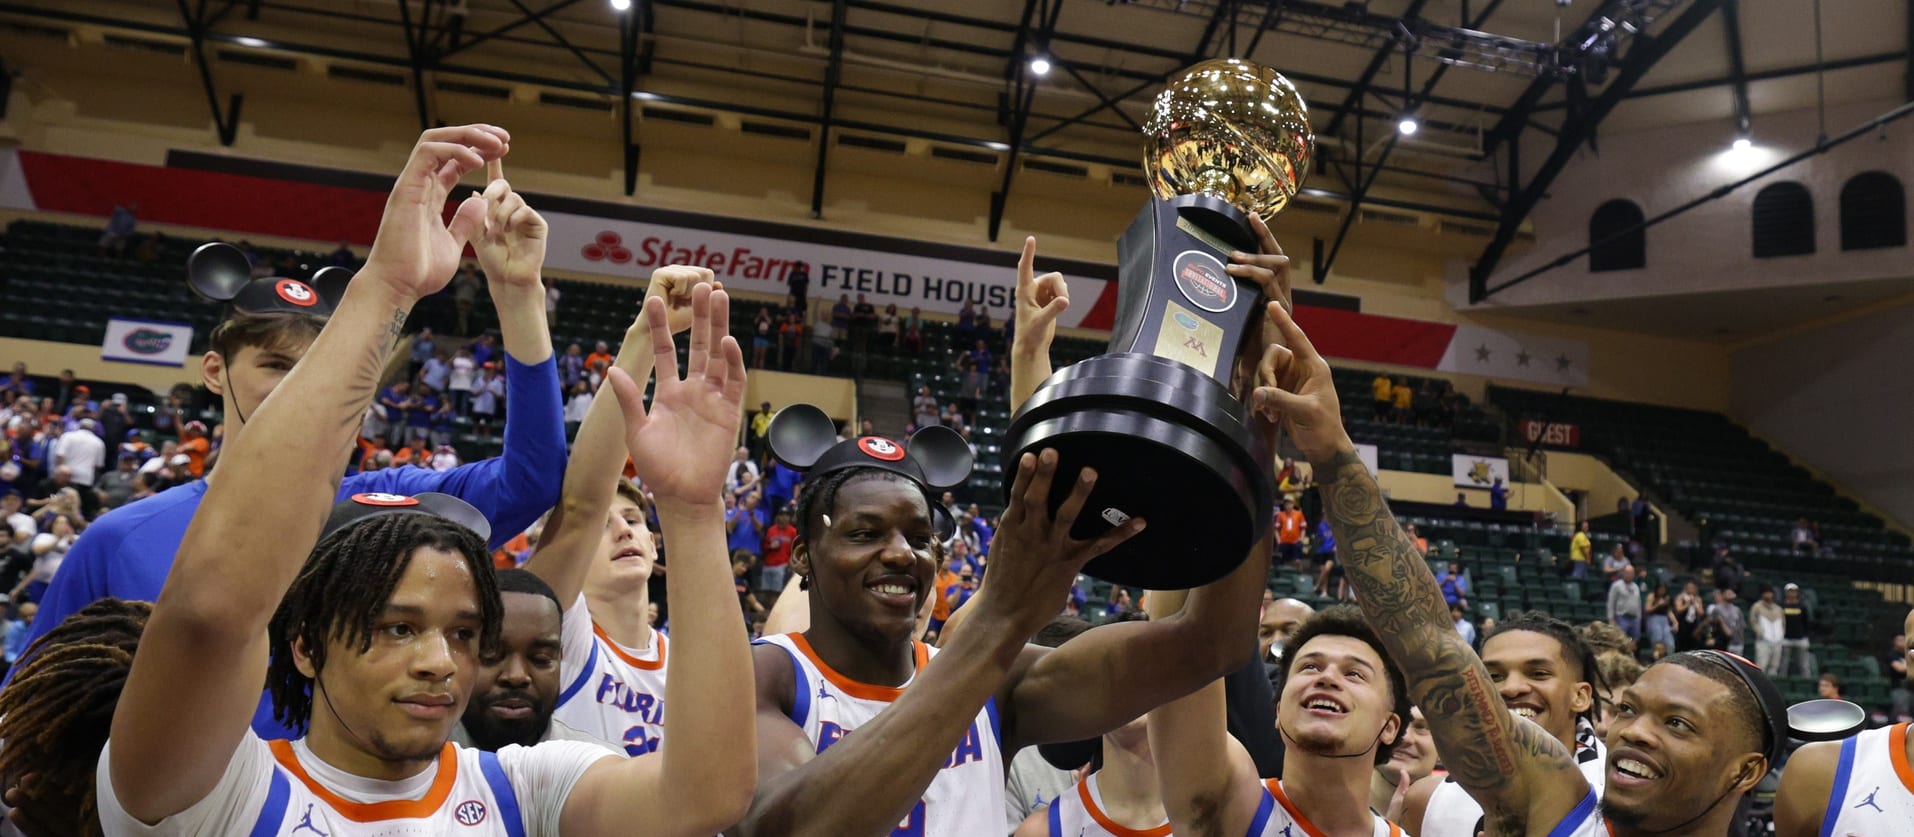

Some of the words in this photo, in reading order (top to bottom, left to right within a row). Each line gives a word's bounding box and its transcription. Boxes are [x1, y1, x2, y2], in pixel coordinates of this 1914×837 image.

[821, 264, 913, 297] FIELD
[1205, 272, 1227, 288] EVENTS
[596, 672, 665, 726] FLORI
[457, 802, 484, 825] SEC
